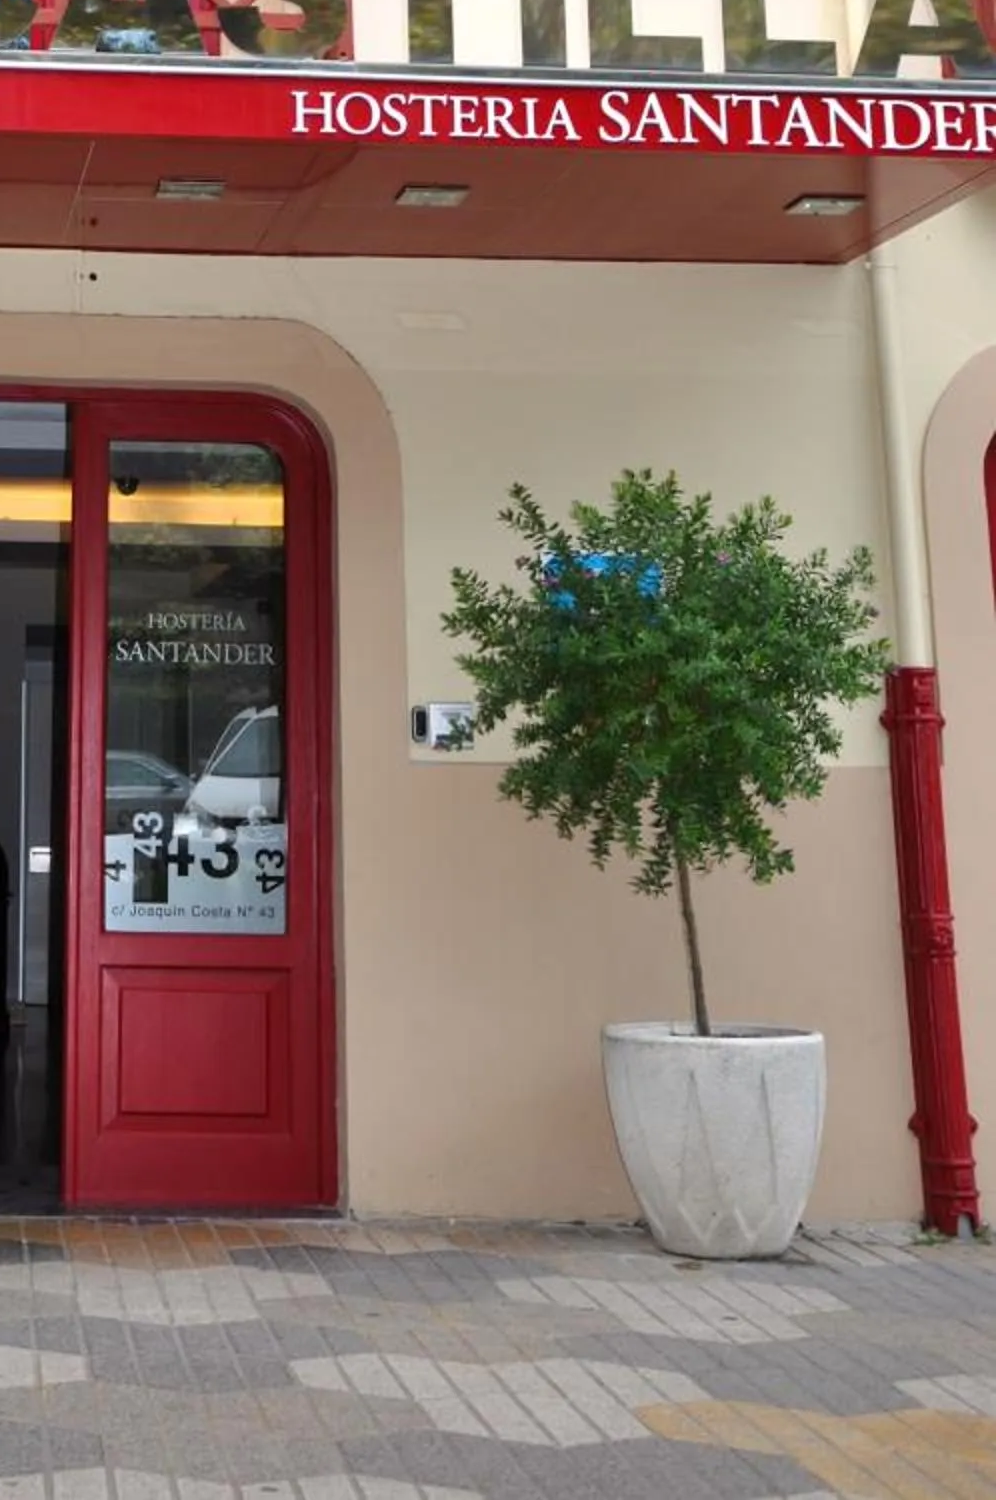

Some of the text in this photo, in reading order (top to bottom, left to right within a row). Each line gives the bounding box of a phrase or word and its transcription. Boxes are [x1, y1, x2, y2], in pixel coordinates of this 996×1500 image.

[291, 90, 995, 153] HOSTERIA SANTANDER
[148, 611, 246, 631] HOSTERÍA
[115, 639, 275, 666] SANTANDER
[132, 811, 163, 858] 43
[111, 905, 125, 918] c/
[191, 905, 231, 918] Costa
[258, 906, 276, 919] 43
